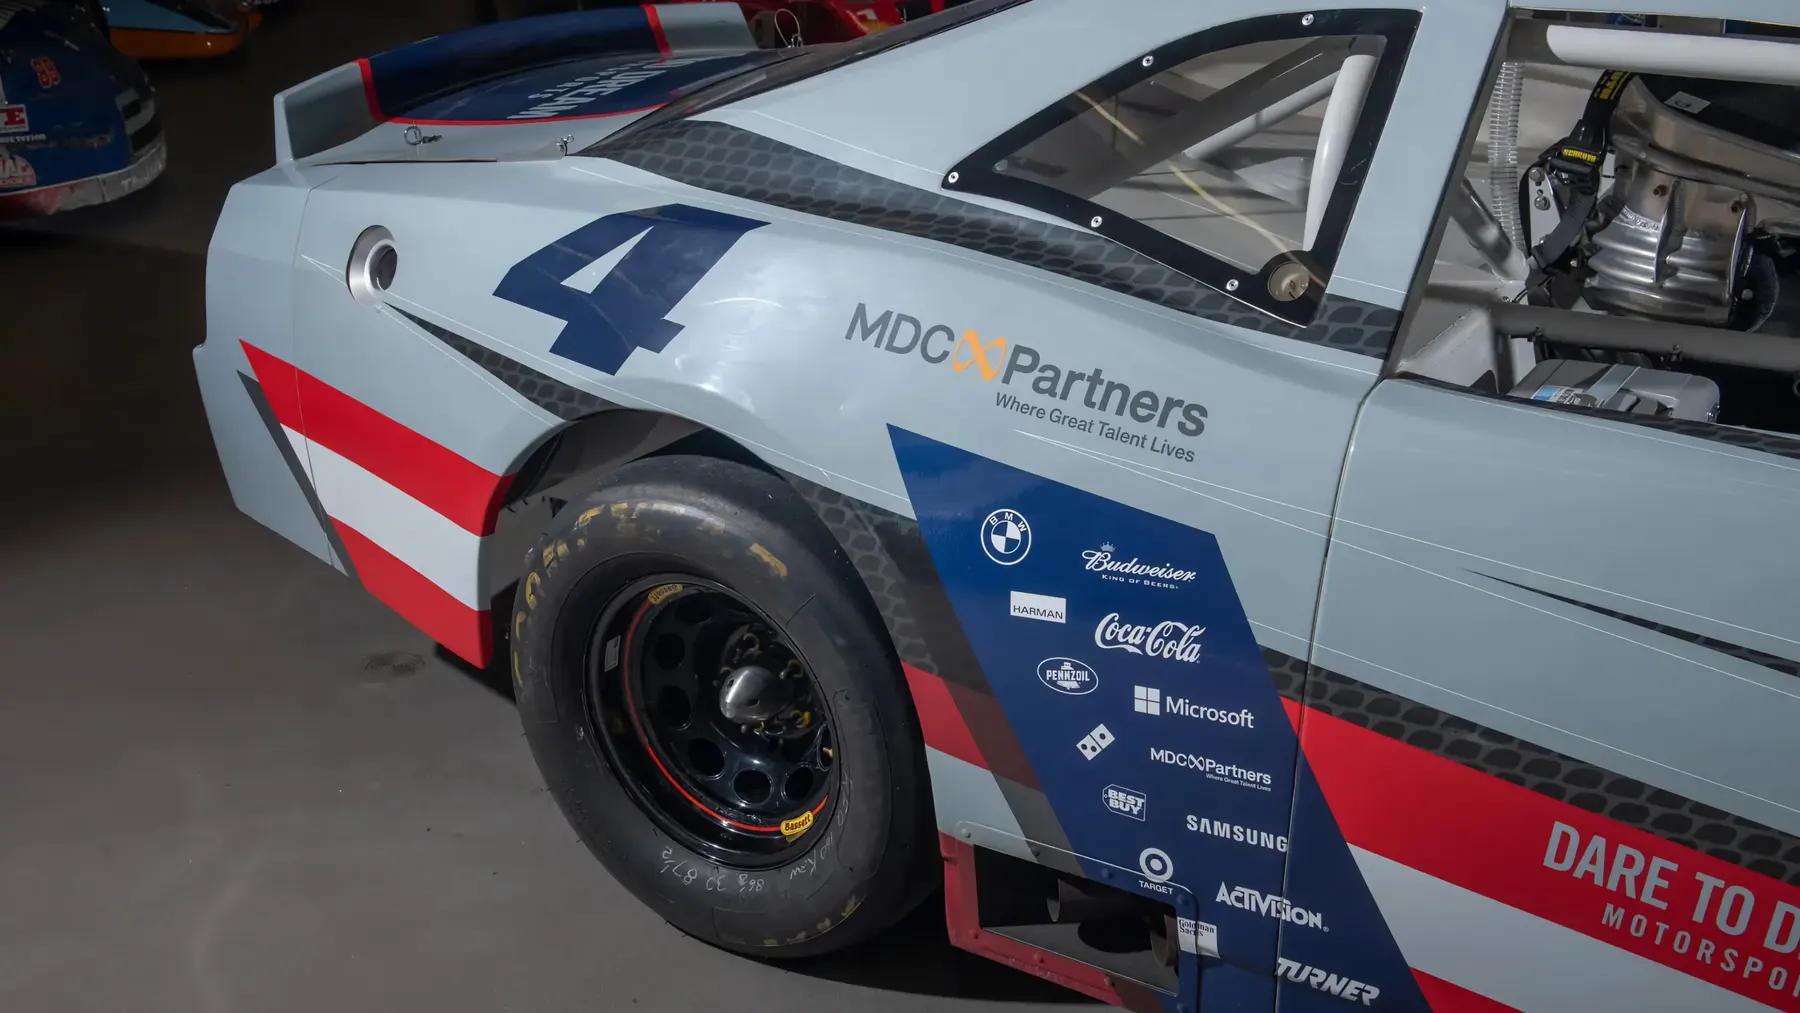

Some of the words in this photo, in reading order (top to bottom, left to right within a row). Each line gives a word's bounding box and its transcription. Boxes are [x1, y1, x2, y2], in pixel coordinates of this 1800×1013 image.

[492, 203, 772, 375] 4
[845, 303, 955, 363] MDC
[1001, 345, 1208, 437] Partners
[995, 392, 1046, 419] Where
[1049, 409, 1094, 433] Great
[1098, 421, 1148, 449] Talent
[1150, 437, 1195, 463] Lives
[989, 511, 1027, 532] BMW
[1082, 550, 1196, 582] Budweiser
[1013, 604, 1063, 620] HARMAN
[1094, 612, 1206, 663] Coca-Cola
[1046, 669, 1090, 682] PENNZOIL
[1166, 696, 1254, 728] Microsoft
[1150, 747, 1187, 766] MDC
[1205, 758, 1271, 785] Partners
[1205, 773, 1223, 782] Where
[1108, 788, 1145, 808] BEST
[1109, 797, 1143, 814] BUY
[785, 814, 811, 831] Bassett
[1186, 814, 1289, 852] SAMSUNG
[1139, 880, 1173, 895] TARGET
[1543, 821, 1679, 910] DARE
[1692, 871, 1755, 936] TO
[1276, 957, 1380, 1006] TURNER
